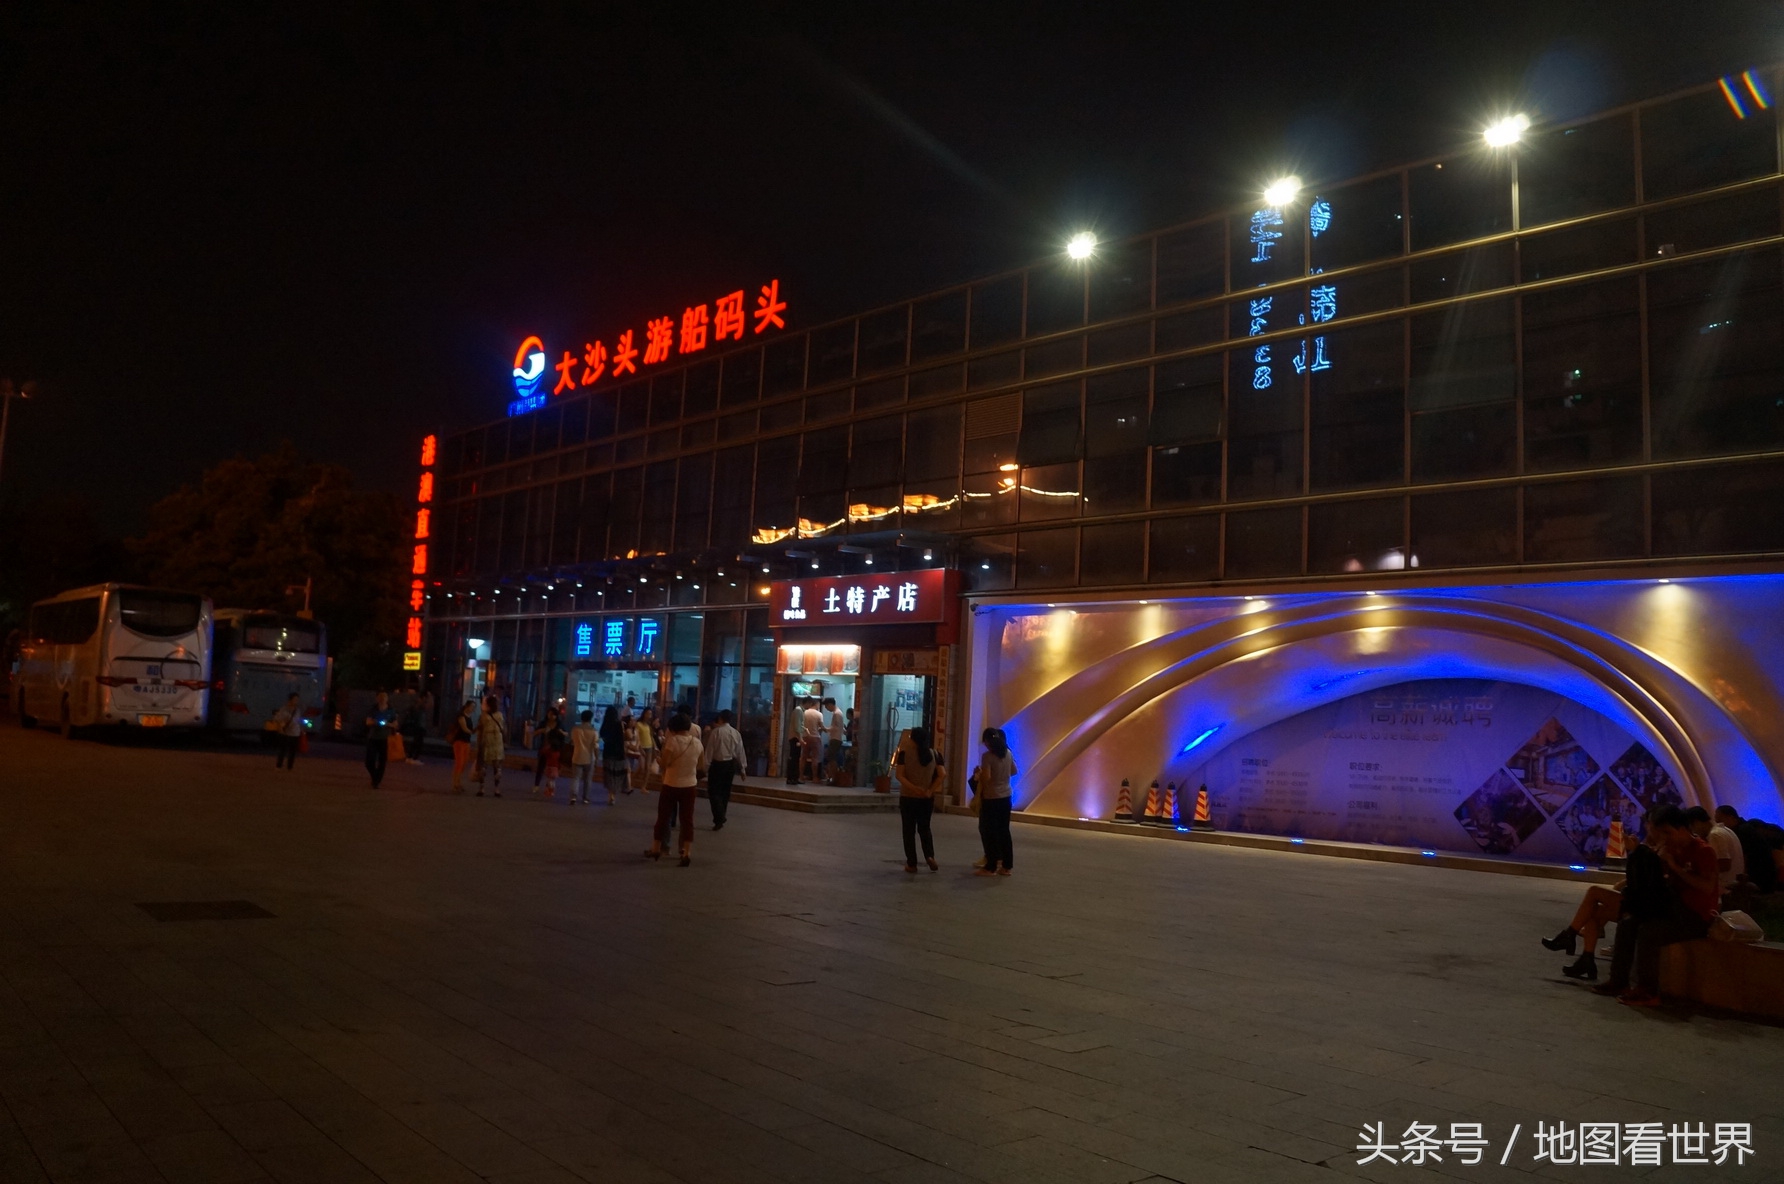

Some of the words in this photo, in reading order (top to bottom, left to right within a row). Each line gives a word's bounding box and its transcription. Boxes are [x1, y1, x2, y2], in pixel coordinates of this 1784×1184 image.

[553, 279, 787, 395] 大沙头游船码头
[822, 582, 919, 615] 土特产店
[576, 621, 658, 656] 售票厅
